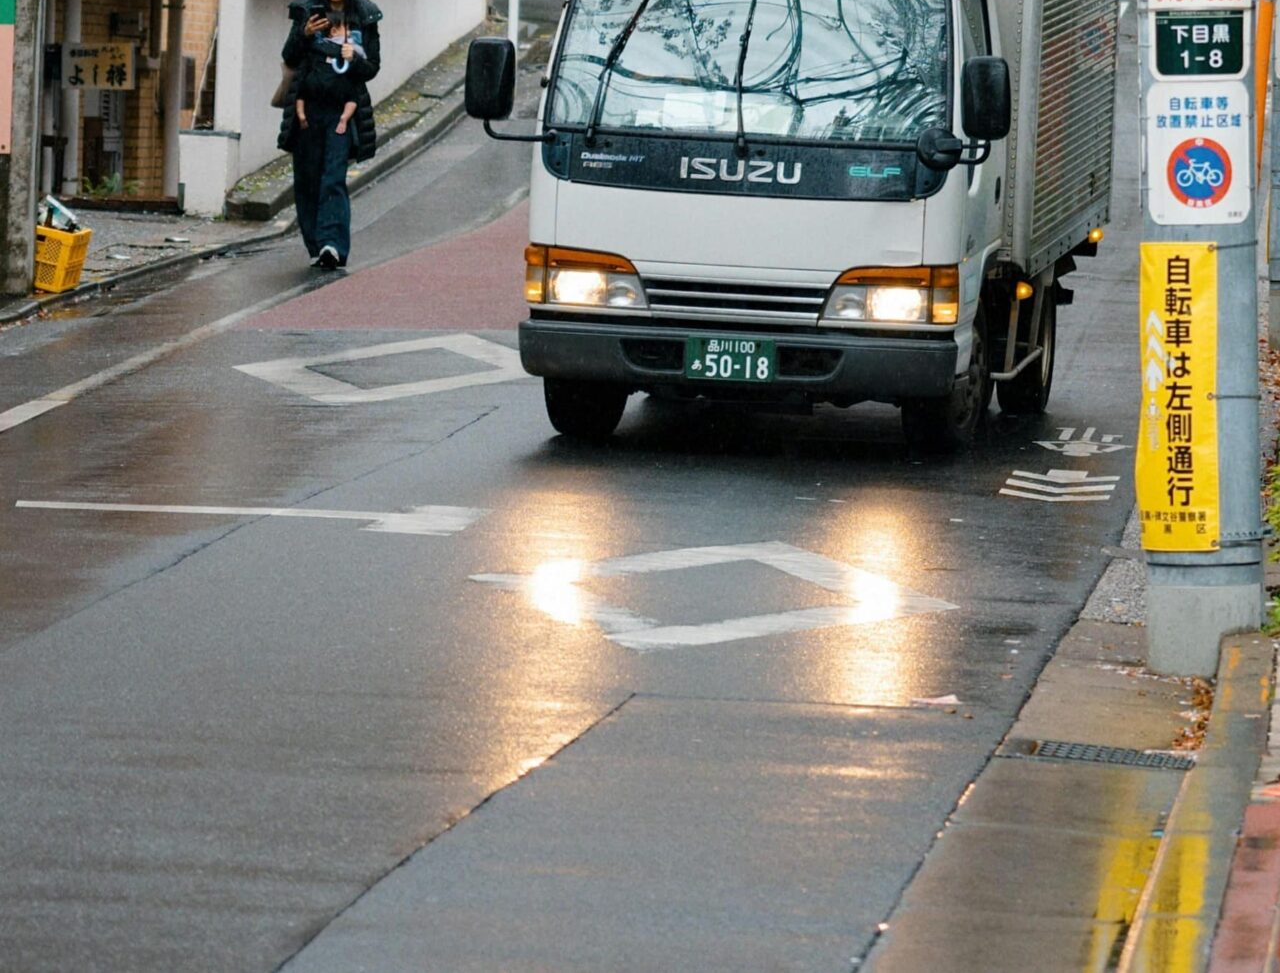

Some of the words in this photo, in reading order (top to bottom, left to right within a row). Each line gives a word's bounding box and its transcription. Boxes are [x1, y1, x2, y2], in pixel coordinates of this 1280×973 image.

[1170, 24, 1231, 44] 下目黒
[1180, 49, 1224, 69] 1-8
[680, 156, 802, 185] ISUZU
[848, 166, 901, 178] ELF
[704, 354, 769, 380] 50-18
[1164, 254, 1195, 507] 自転車は左側通行
